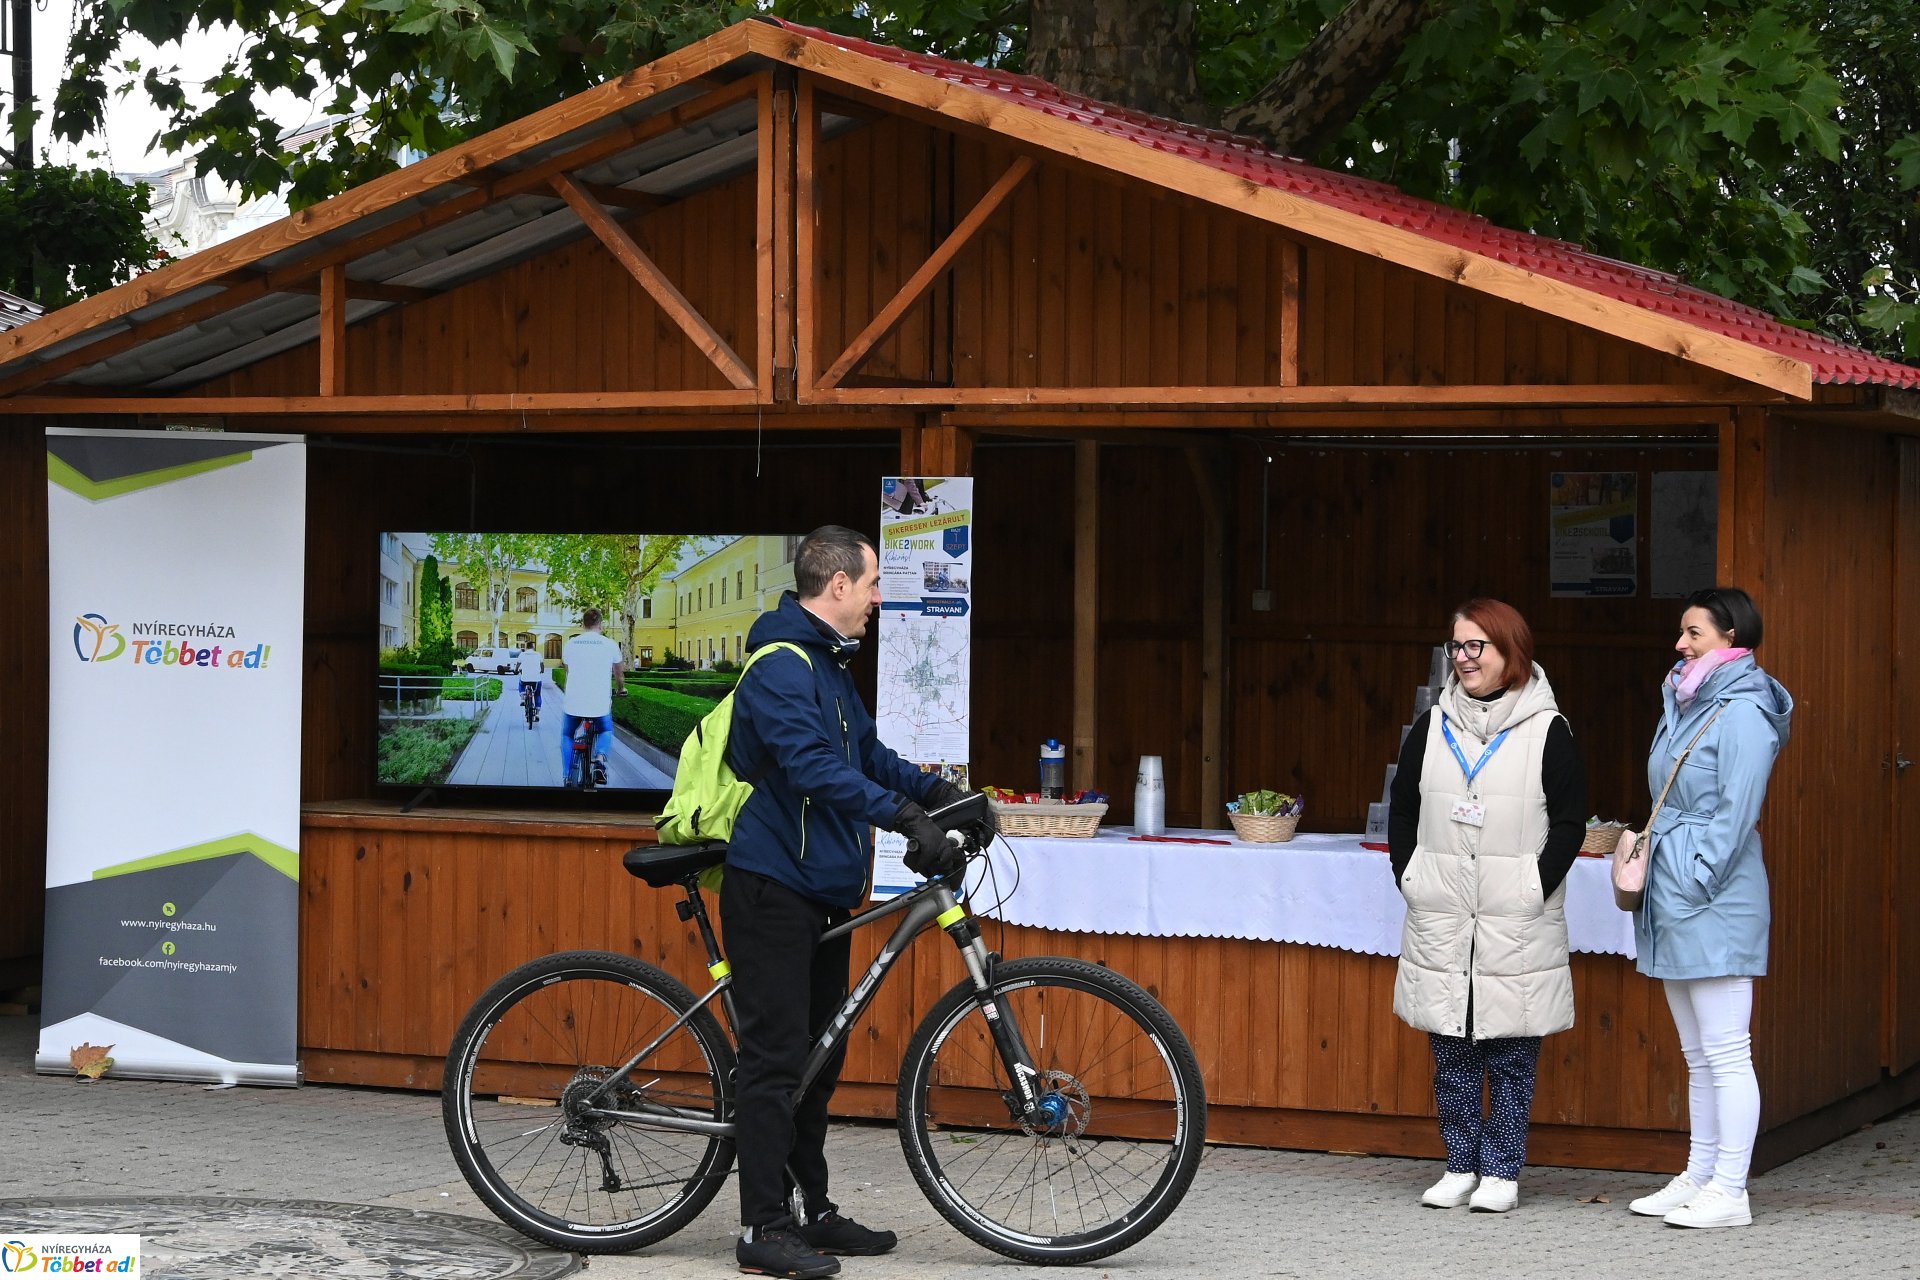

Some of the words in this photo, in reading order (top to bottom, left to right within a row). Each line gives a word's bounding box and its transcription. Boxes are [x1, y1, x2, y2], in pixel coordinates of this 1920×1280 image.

[888, 522, 928, 535] SIKERESEN
[930, 514, 965, 527] LEZÁRULT
[884, 539, 935, 550] BIKE2WORK
[132, 620, 236, 639] NYÍREGYHÁZA
[132, 640, 222, 667] Többet
[227, 643, 271, 669] ad!
[120, 919, 217, 932] www.nyiregyhaza.hu
[99, 956, 238, 974] facebook.com/nyiregyhazamjv
[815, 943, 896, 1049] TREK
